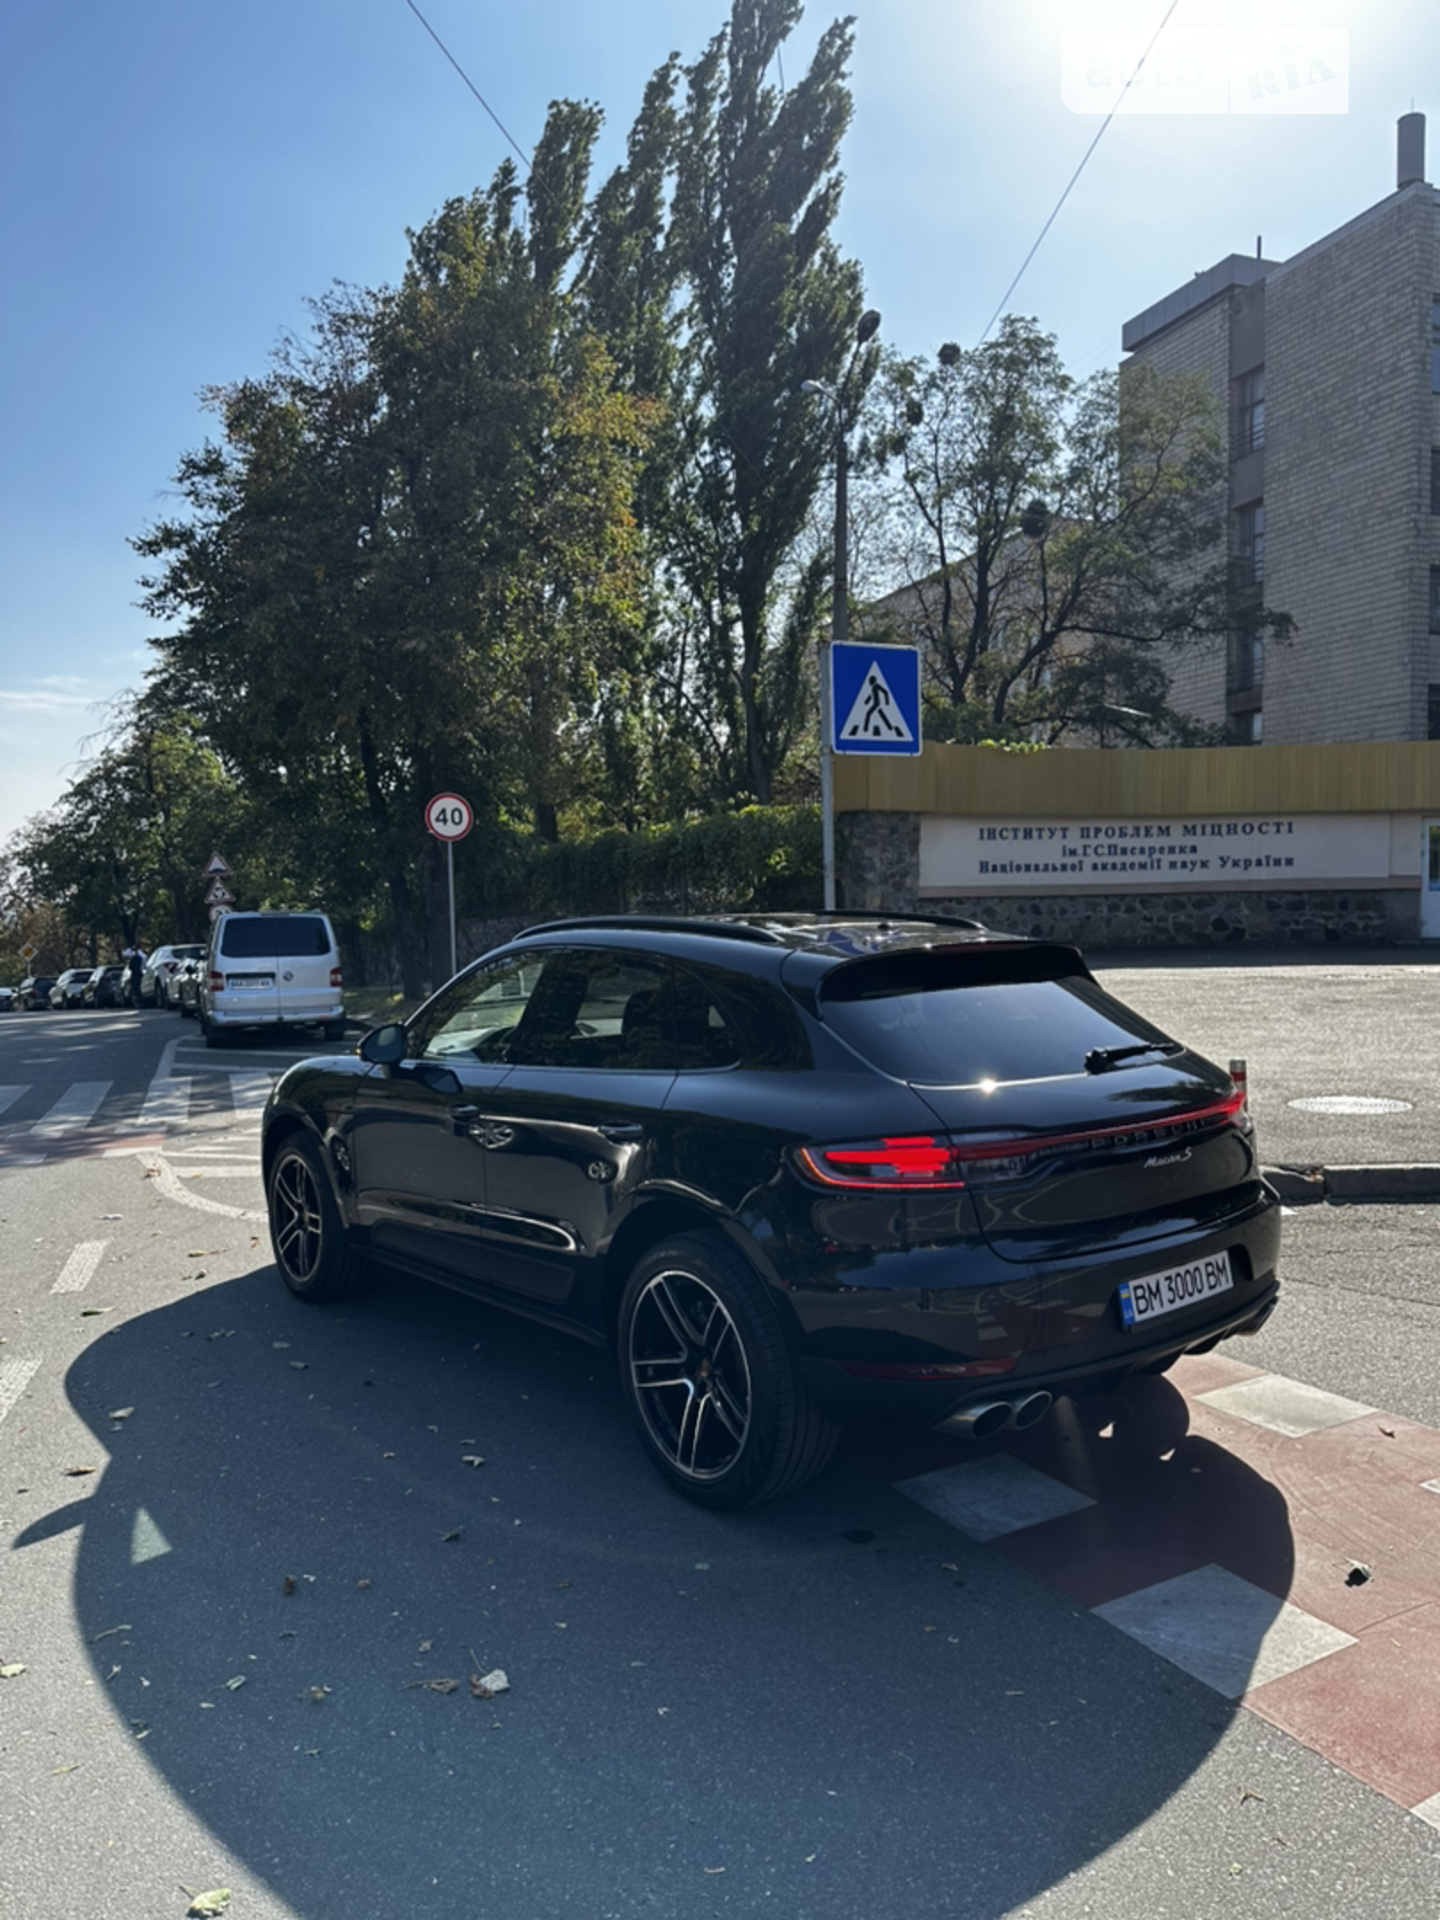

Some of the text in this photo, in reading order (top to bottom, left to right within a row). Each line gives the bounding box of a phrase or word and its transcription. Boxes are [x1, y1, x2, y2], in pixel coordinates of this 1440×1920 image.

[435, 807, 463, 826] 40
[978, 821, 1294, 840] ІНСТИТУТ ПРОБЛЕМ МІЦНОСТІ
[978, 855, 1294, 874] Національної академії наук України
[1180, 1146, 1192, 1162] S
[1133, 1256, 1229, 1316] BM 3000 BM
